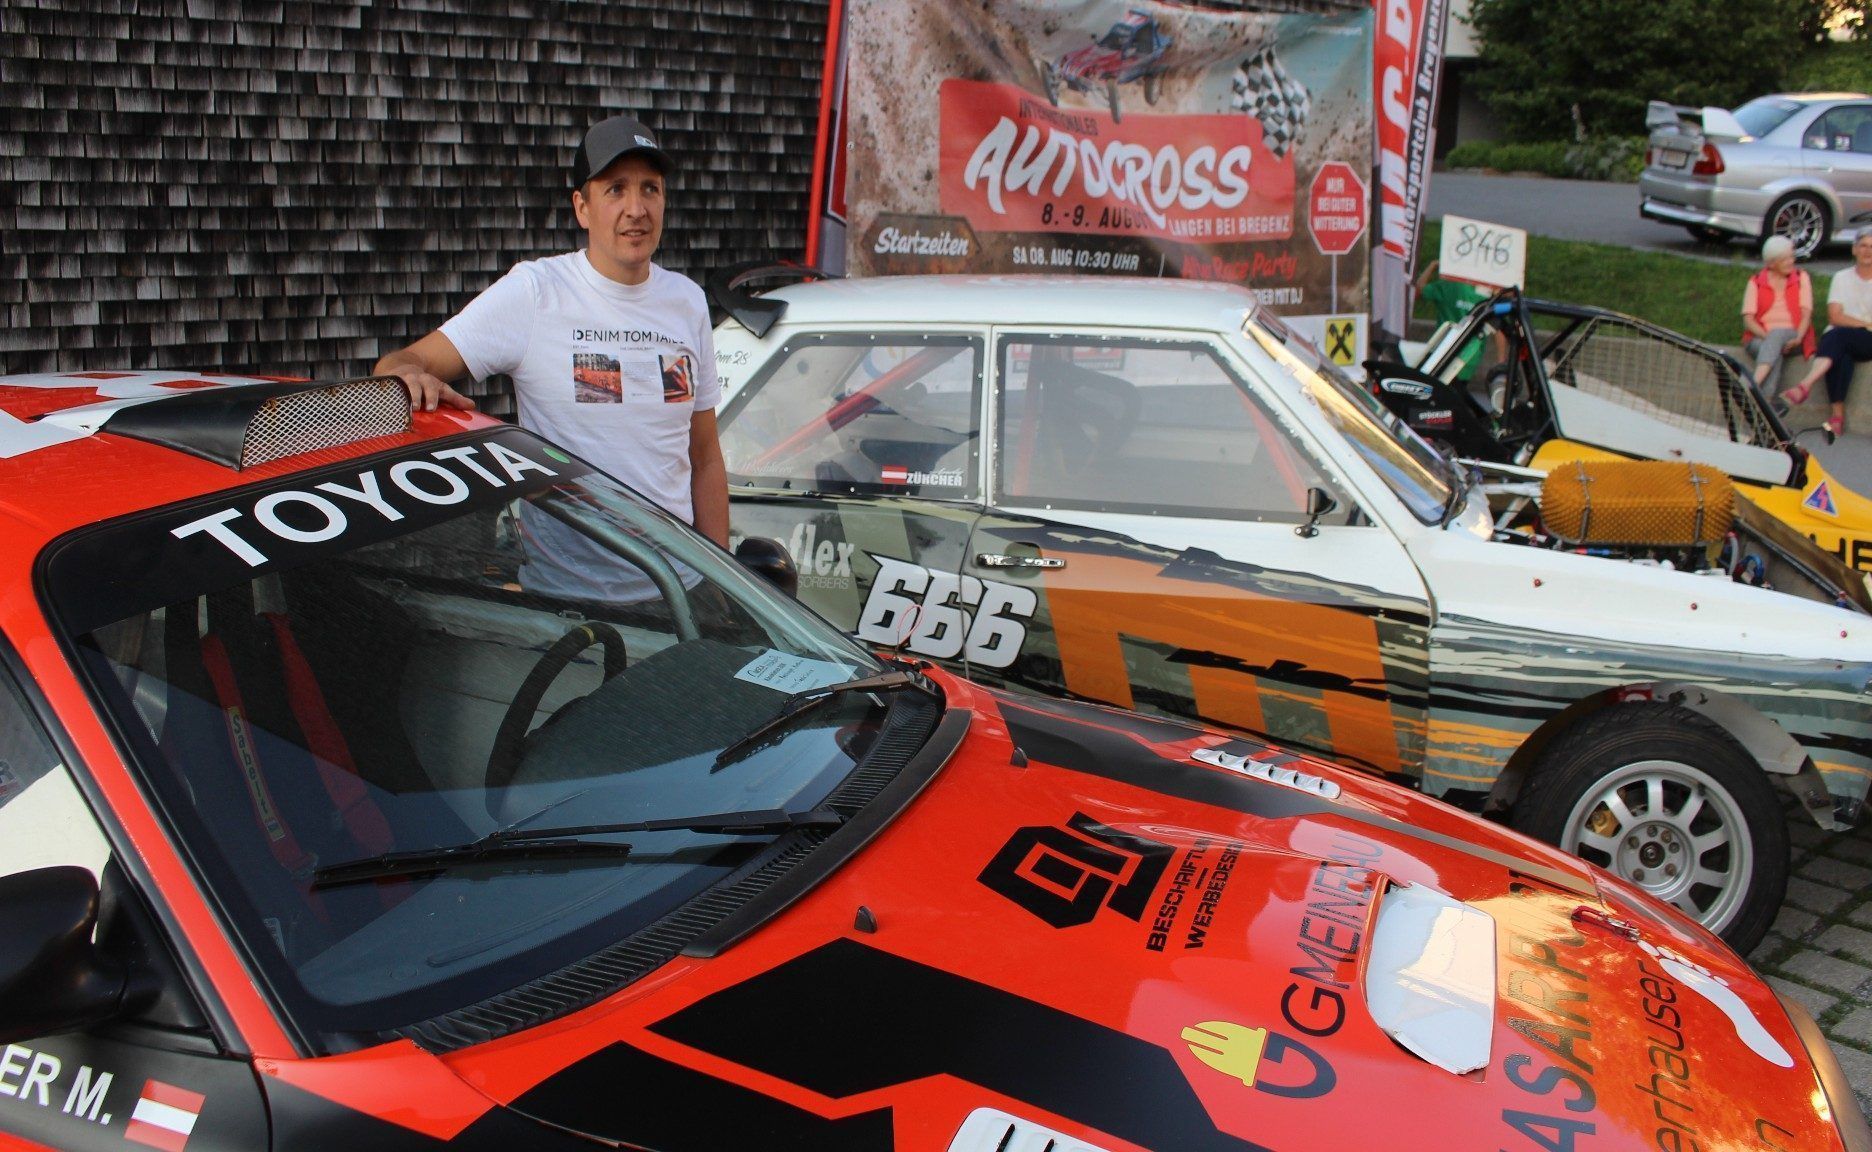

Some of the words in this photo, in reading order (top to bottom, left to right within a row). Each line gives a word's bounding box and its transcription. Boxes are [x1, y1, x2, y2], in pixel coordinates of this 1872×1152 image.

[963, 115, 1252, 229] AUTOCROSS
[874, 226, 969, 256] Startzeiten
[1215, 216, 1235, 235] BEI
[1239, 215, 1290, 234] BREGENZ
[1012, 246, 1027, 265] SA
[1029, 247, 1048, 266] 08.
[1051, 248, 1073, 267] AUG
[1074, 250, 1110, 269] 10:30
[1112, 253, 1139, 271] UHR
[1456, 223, 1512, 266] 846
[1251, 250, 1298, 282] Party
[623, 330, 652, 342] TOM
[170, 441, 558, 568] TOYOTA
[797, 576, 850, 590] SORBERS
[852, 551, 1039, 669] 666
[62, 1065, 115, 1126] M.
